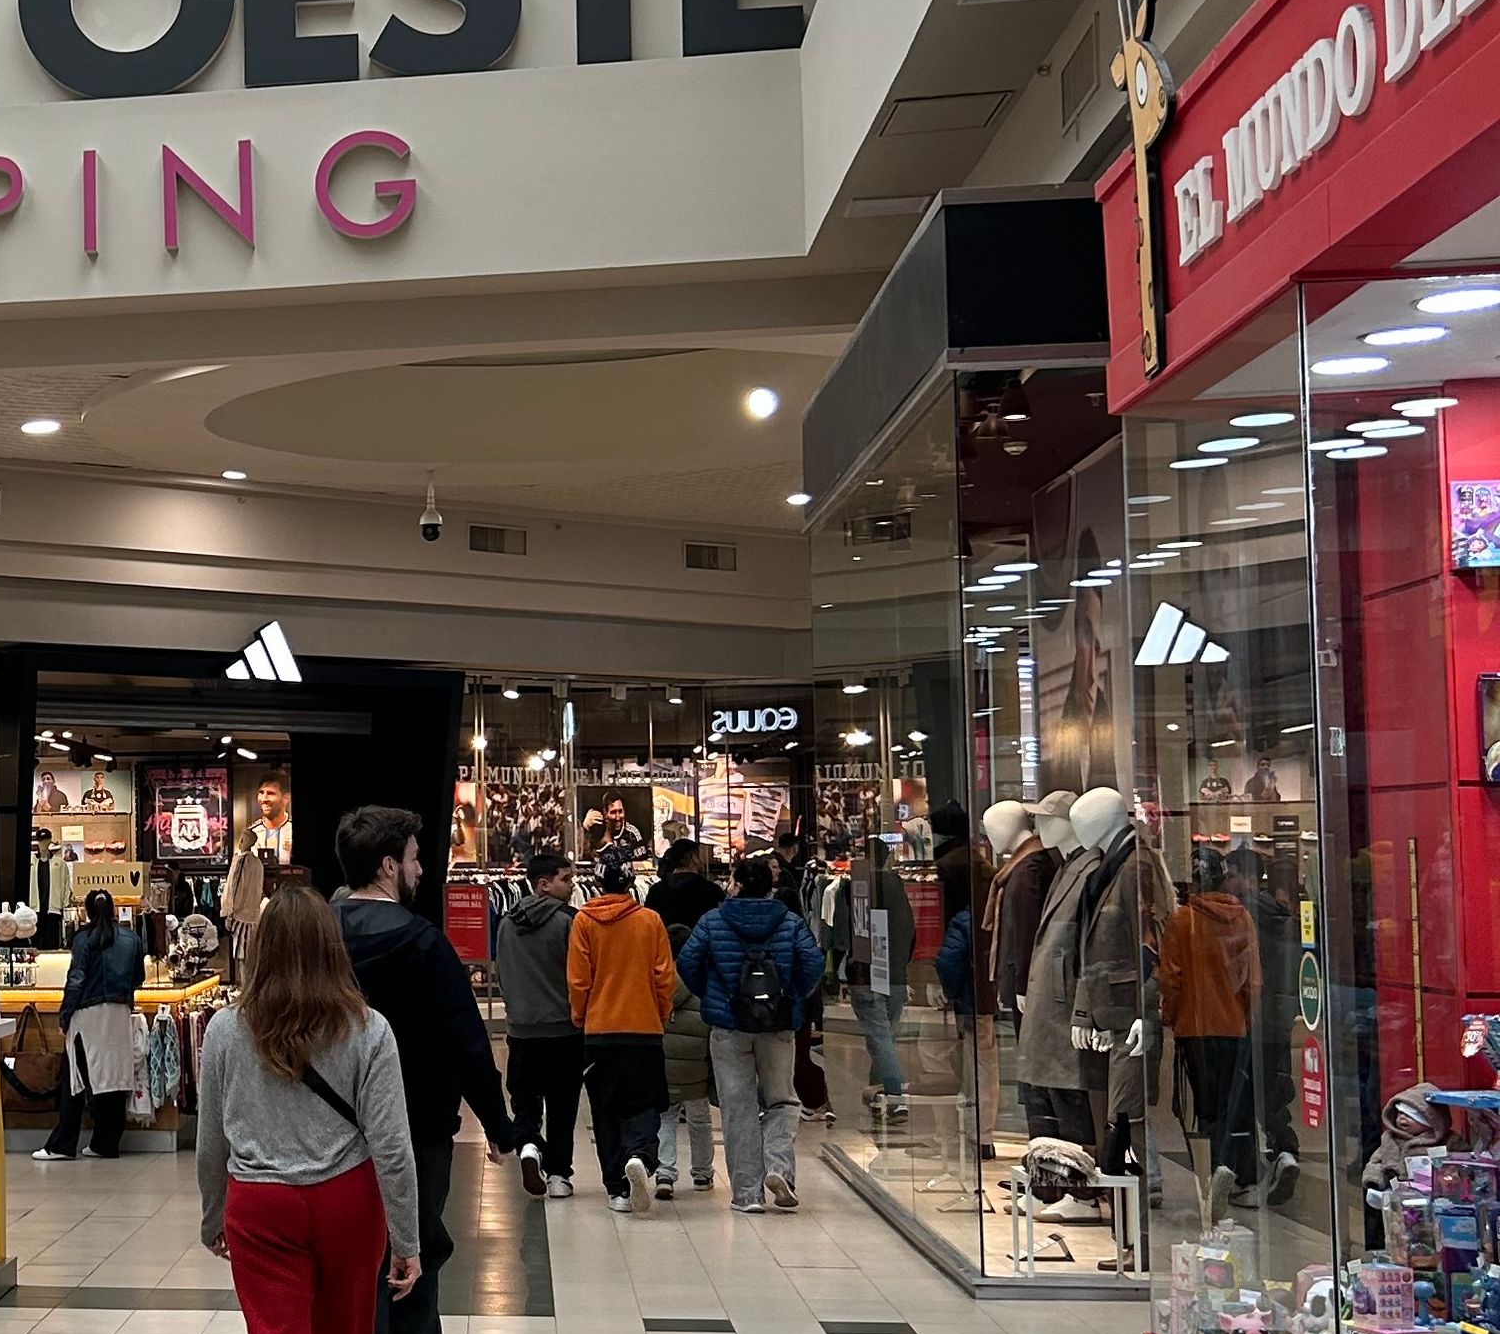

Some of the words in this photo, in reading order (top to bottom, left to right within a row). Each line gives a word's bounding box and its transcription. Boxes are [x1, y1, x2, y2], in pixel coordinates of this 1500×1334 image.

[1173, 155, 1223, 267] EL
[1222, 4, 1377, 225] MUNDO
[76, 871, 126, 886] ramira
